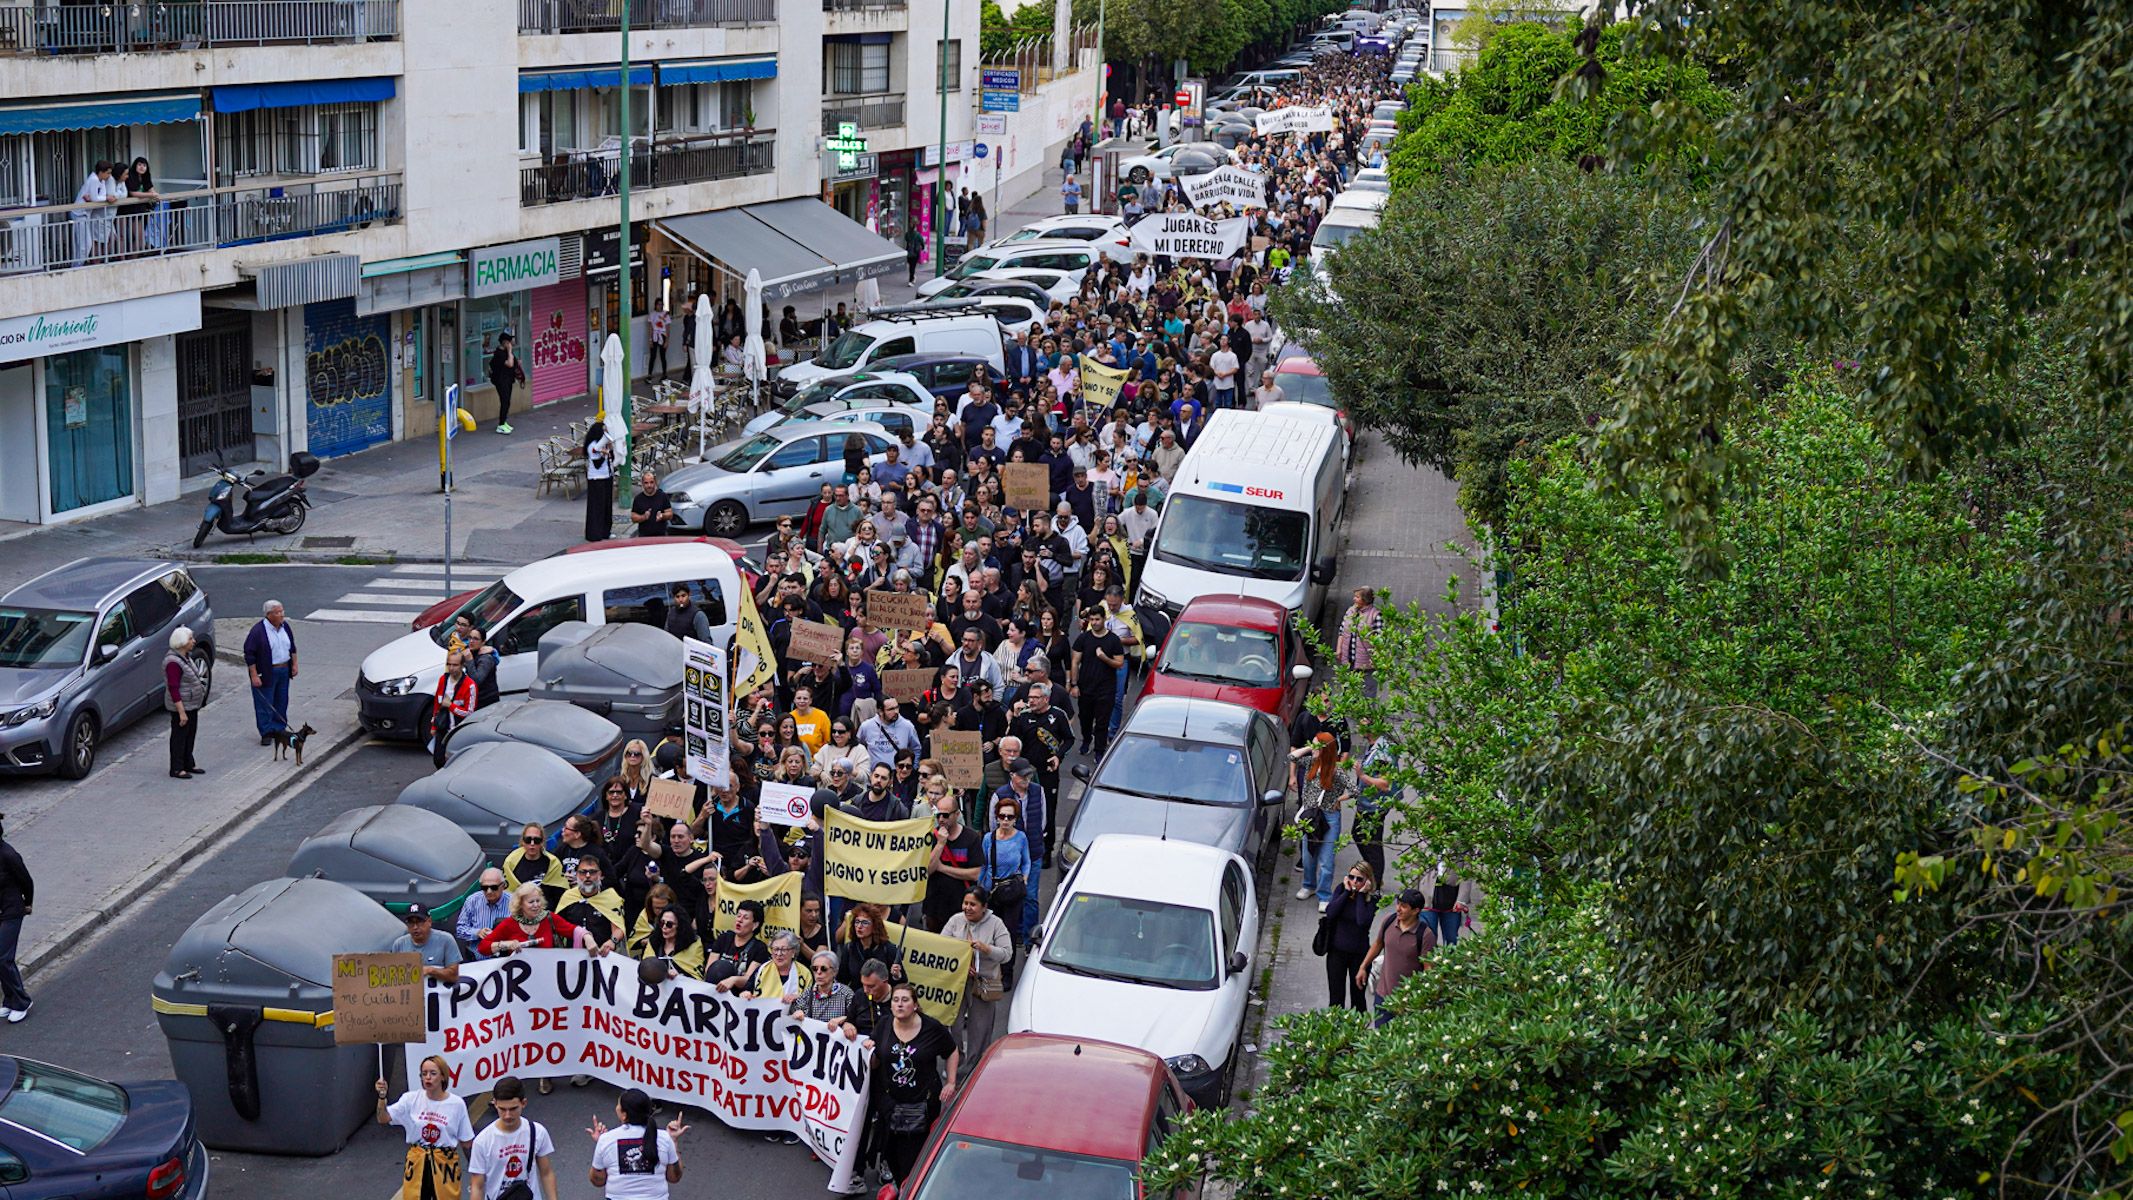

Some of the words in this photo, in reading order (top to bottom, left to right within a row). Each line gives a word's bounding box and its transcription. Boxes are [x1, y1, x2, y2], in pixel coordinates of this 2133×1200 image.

[1237, 187, 1256, 199] VIDA
[1161, 217, 1201, 233] JUGAR
[1204, 221, 1218, 235] ES
[1154, 238, 1169, 253] MI
[1173, 238, 1225, 255] DERECHO
[477, 249, 557, 287] FARMACIA
[15, 332, 26, 344] EN
[27, 314, 100, 344] Movimiento
[1245, 485, 1284, 500] SEUR
[870, 593, 910, 606] ESCUCHA
[829, 826, 861, 848] ¡POR
[865, 831, 887, 851] UN
[825, 860, 865, 884] DIGNO
[868, 868, 878, 885] Y
[881, 866, 928, 885] SEGUR
[909, 948, 959, 973] BARRIO
[912, 982, 958, 1006] GURO!
[428, 959, 532, 1032] ¡POR
[556, 959, 620, 1007] UN
[632, 979, 785, 1052] BARRIO
[785, 1025, 867, 1094] DIGN
[443, 1010, 515, 1053] BASTA
[528, 1006, 569, 1031] DE
[581, 1005, 749, 1086] INSEGURIDAD,
[474, 1041, 567, 1082] OLVIDO
[579, 1040, 803, 1123] ADMINISTRATIVO
[422, 1126, 440, 1139] STOP
